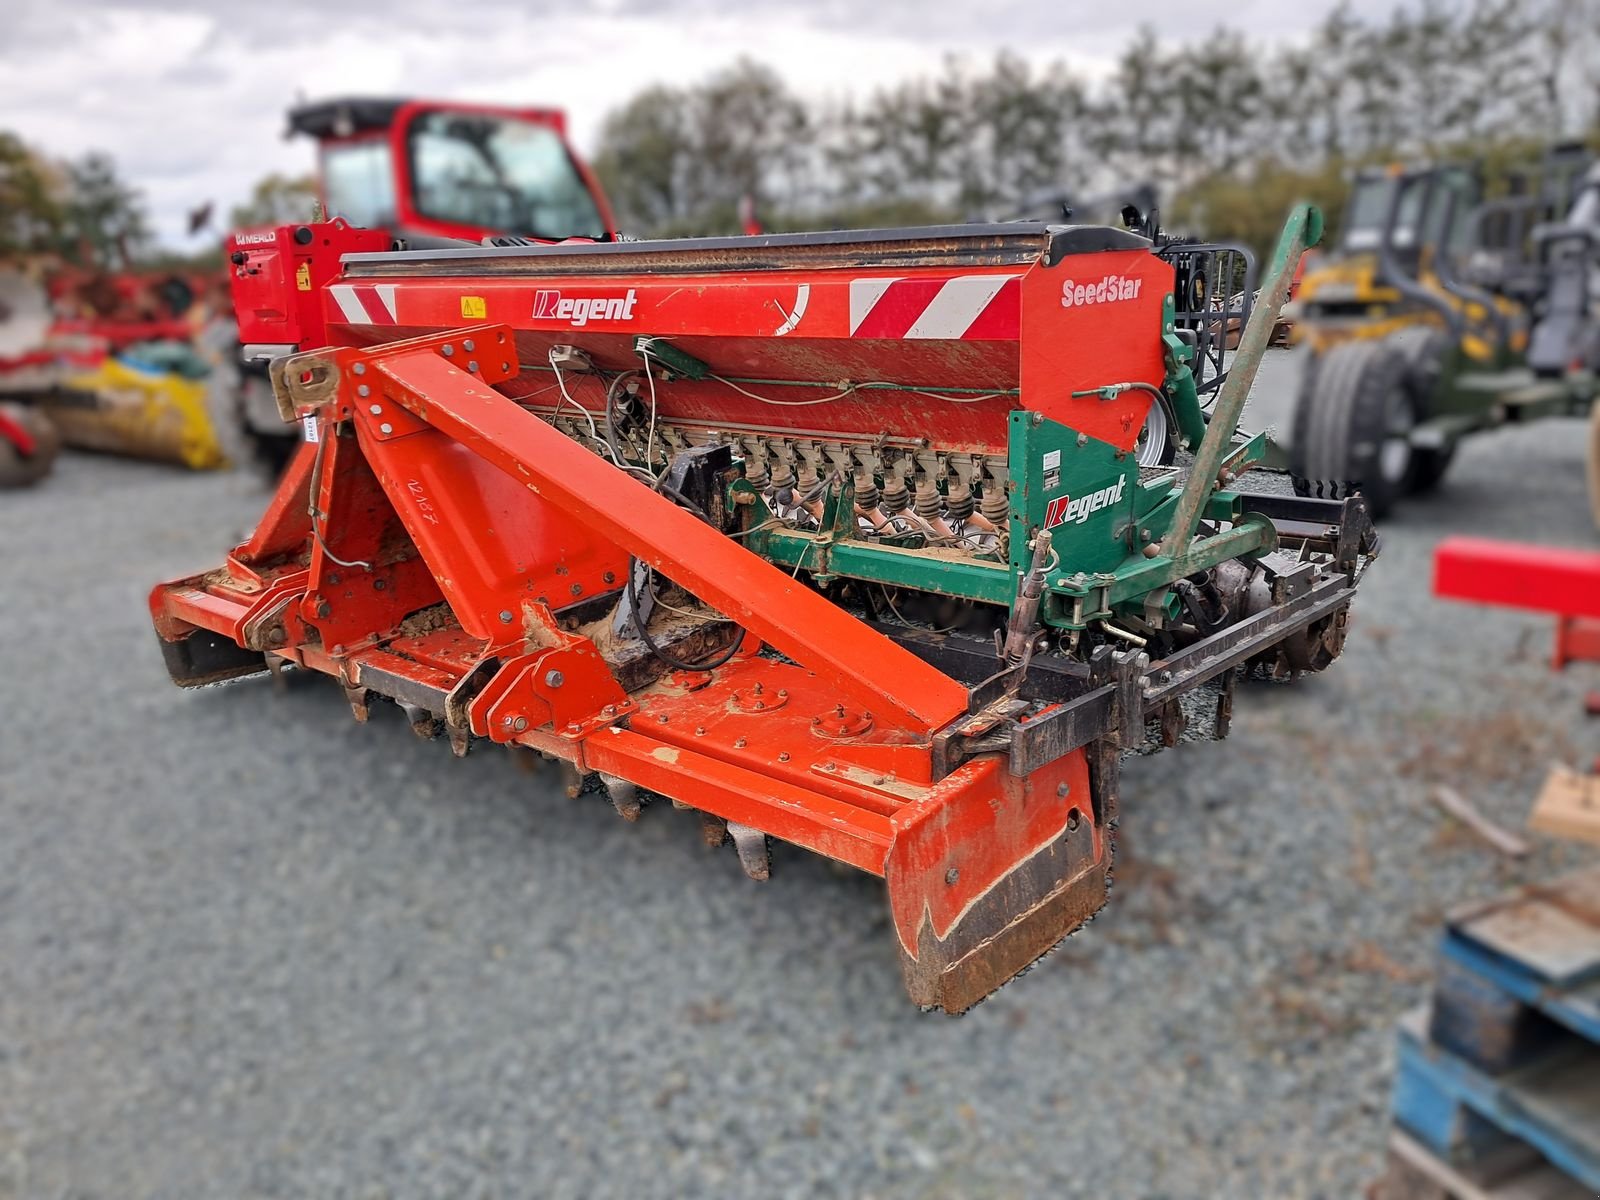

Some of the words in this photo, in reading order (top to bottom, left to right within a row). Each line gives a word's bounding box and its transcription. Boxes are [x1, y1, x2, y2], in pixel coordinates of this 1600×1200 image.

[532, 289, 637, 326] Regent
[1061, 275, 1142, 307] SeedStar
[1043, 473, 1126, 530] Regent
